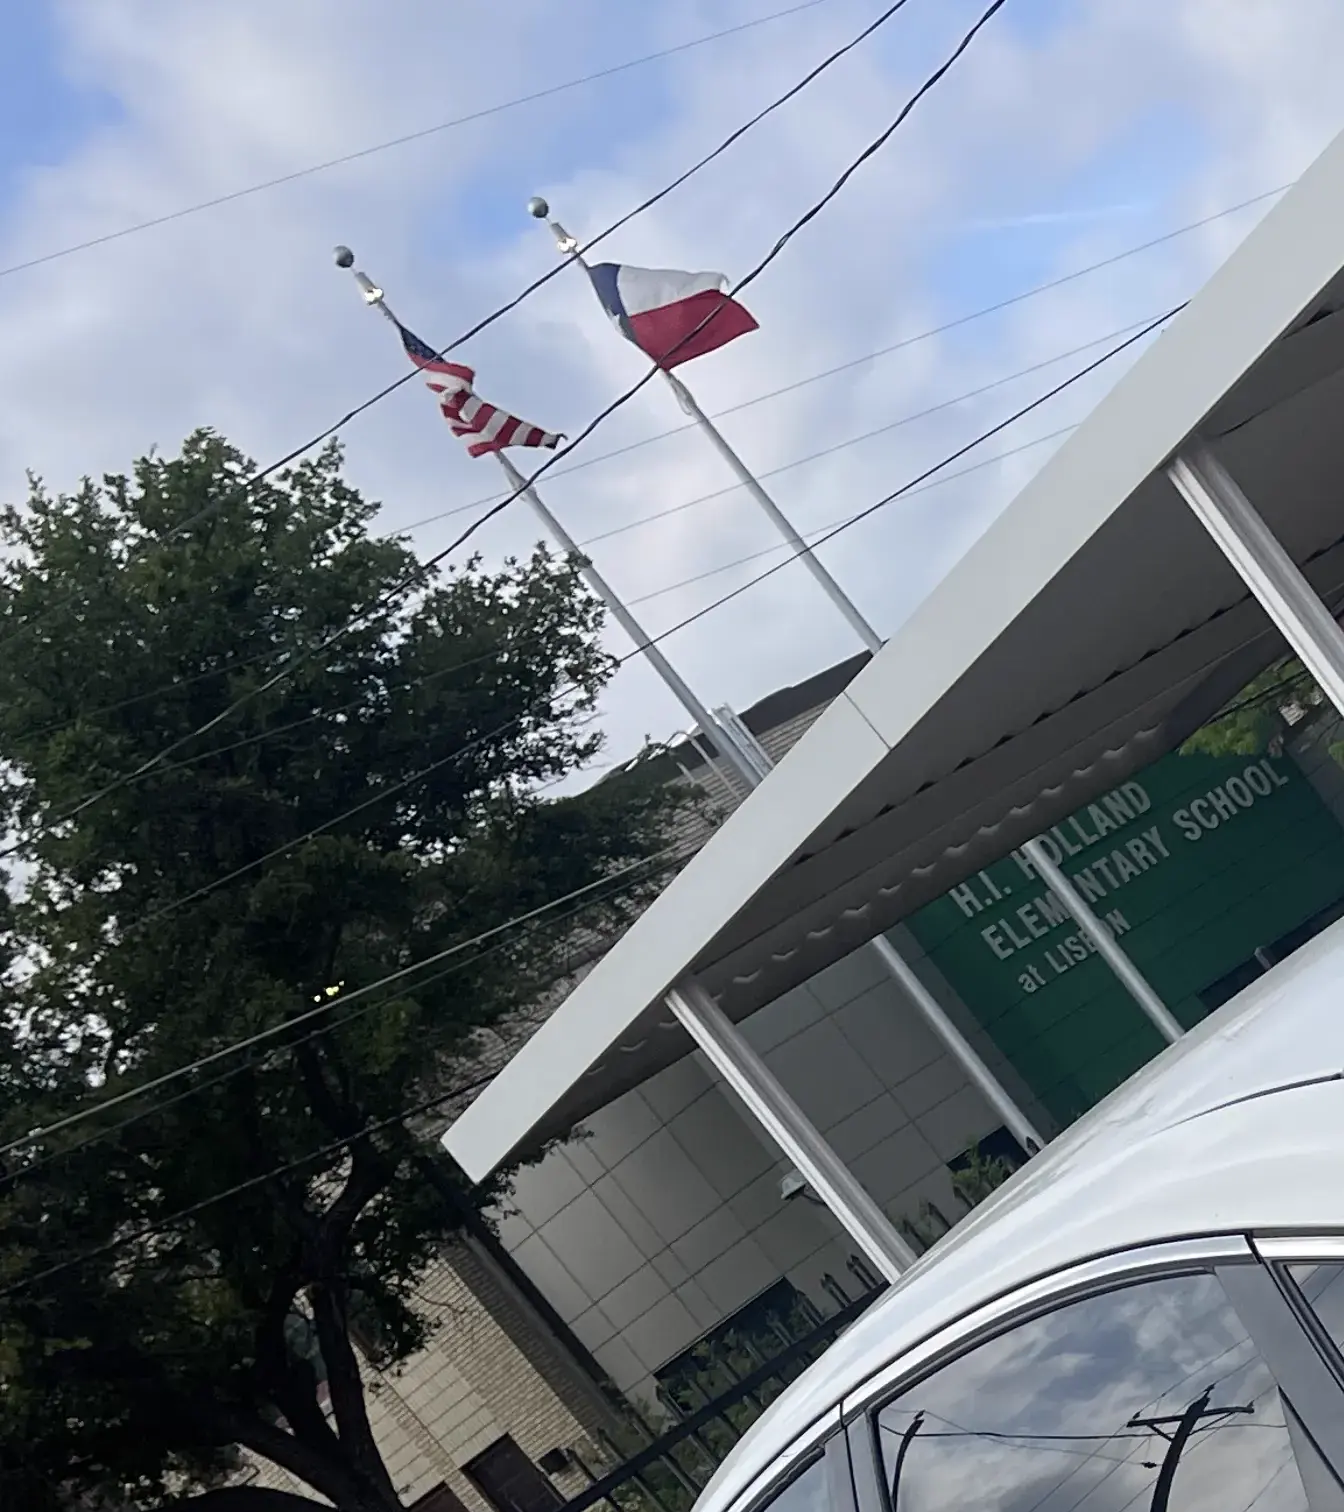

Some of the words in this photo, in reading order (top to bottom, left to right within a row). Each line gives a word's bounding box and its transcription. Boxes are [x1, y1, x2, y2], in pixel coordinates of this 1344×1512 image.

[949, 871, 1013, 918] H.I.
[1010, 781, 1152, 881] HOLLAND
[980, 826, 1172, 960] ELEMNTARY
[1172, 758, 1289, 841] SCHOOL
[1017, 963, 1047, 994] at
